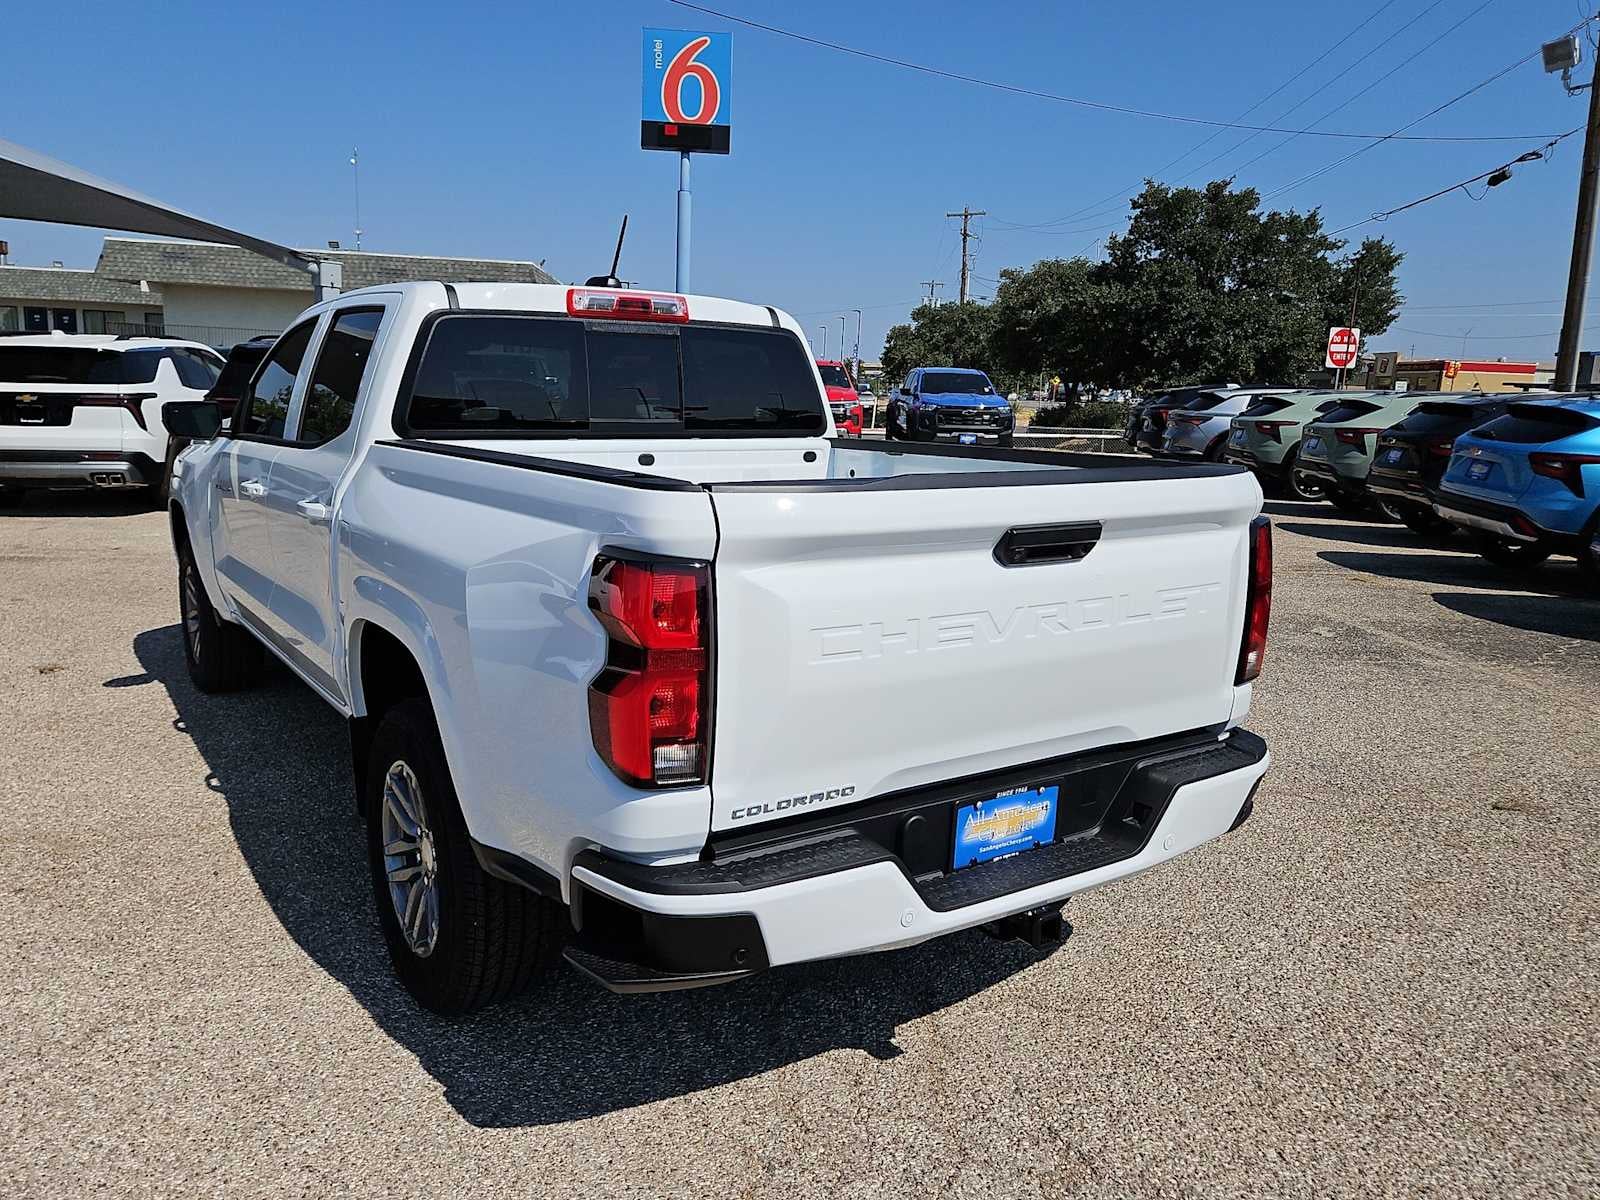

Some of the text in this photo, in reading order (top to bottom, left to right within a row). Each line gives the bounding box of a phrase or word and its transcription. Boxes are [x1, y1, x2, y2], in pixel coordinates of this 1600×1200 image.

[653, 39, 663, 69] motel
[661, 36, 720, 124] 6
[1333, 335, 1342, 343] DO
[807, 581, 1221, 665] CHEVROLET
[731, 785, 856, 820] COLORADO
[964, 801, 1050, 828] All American
